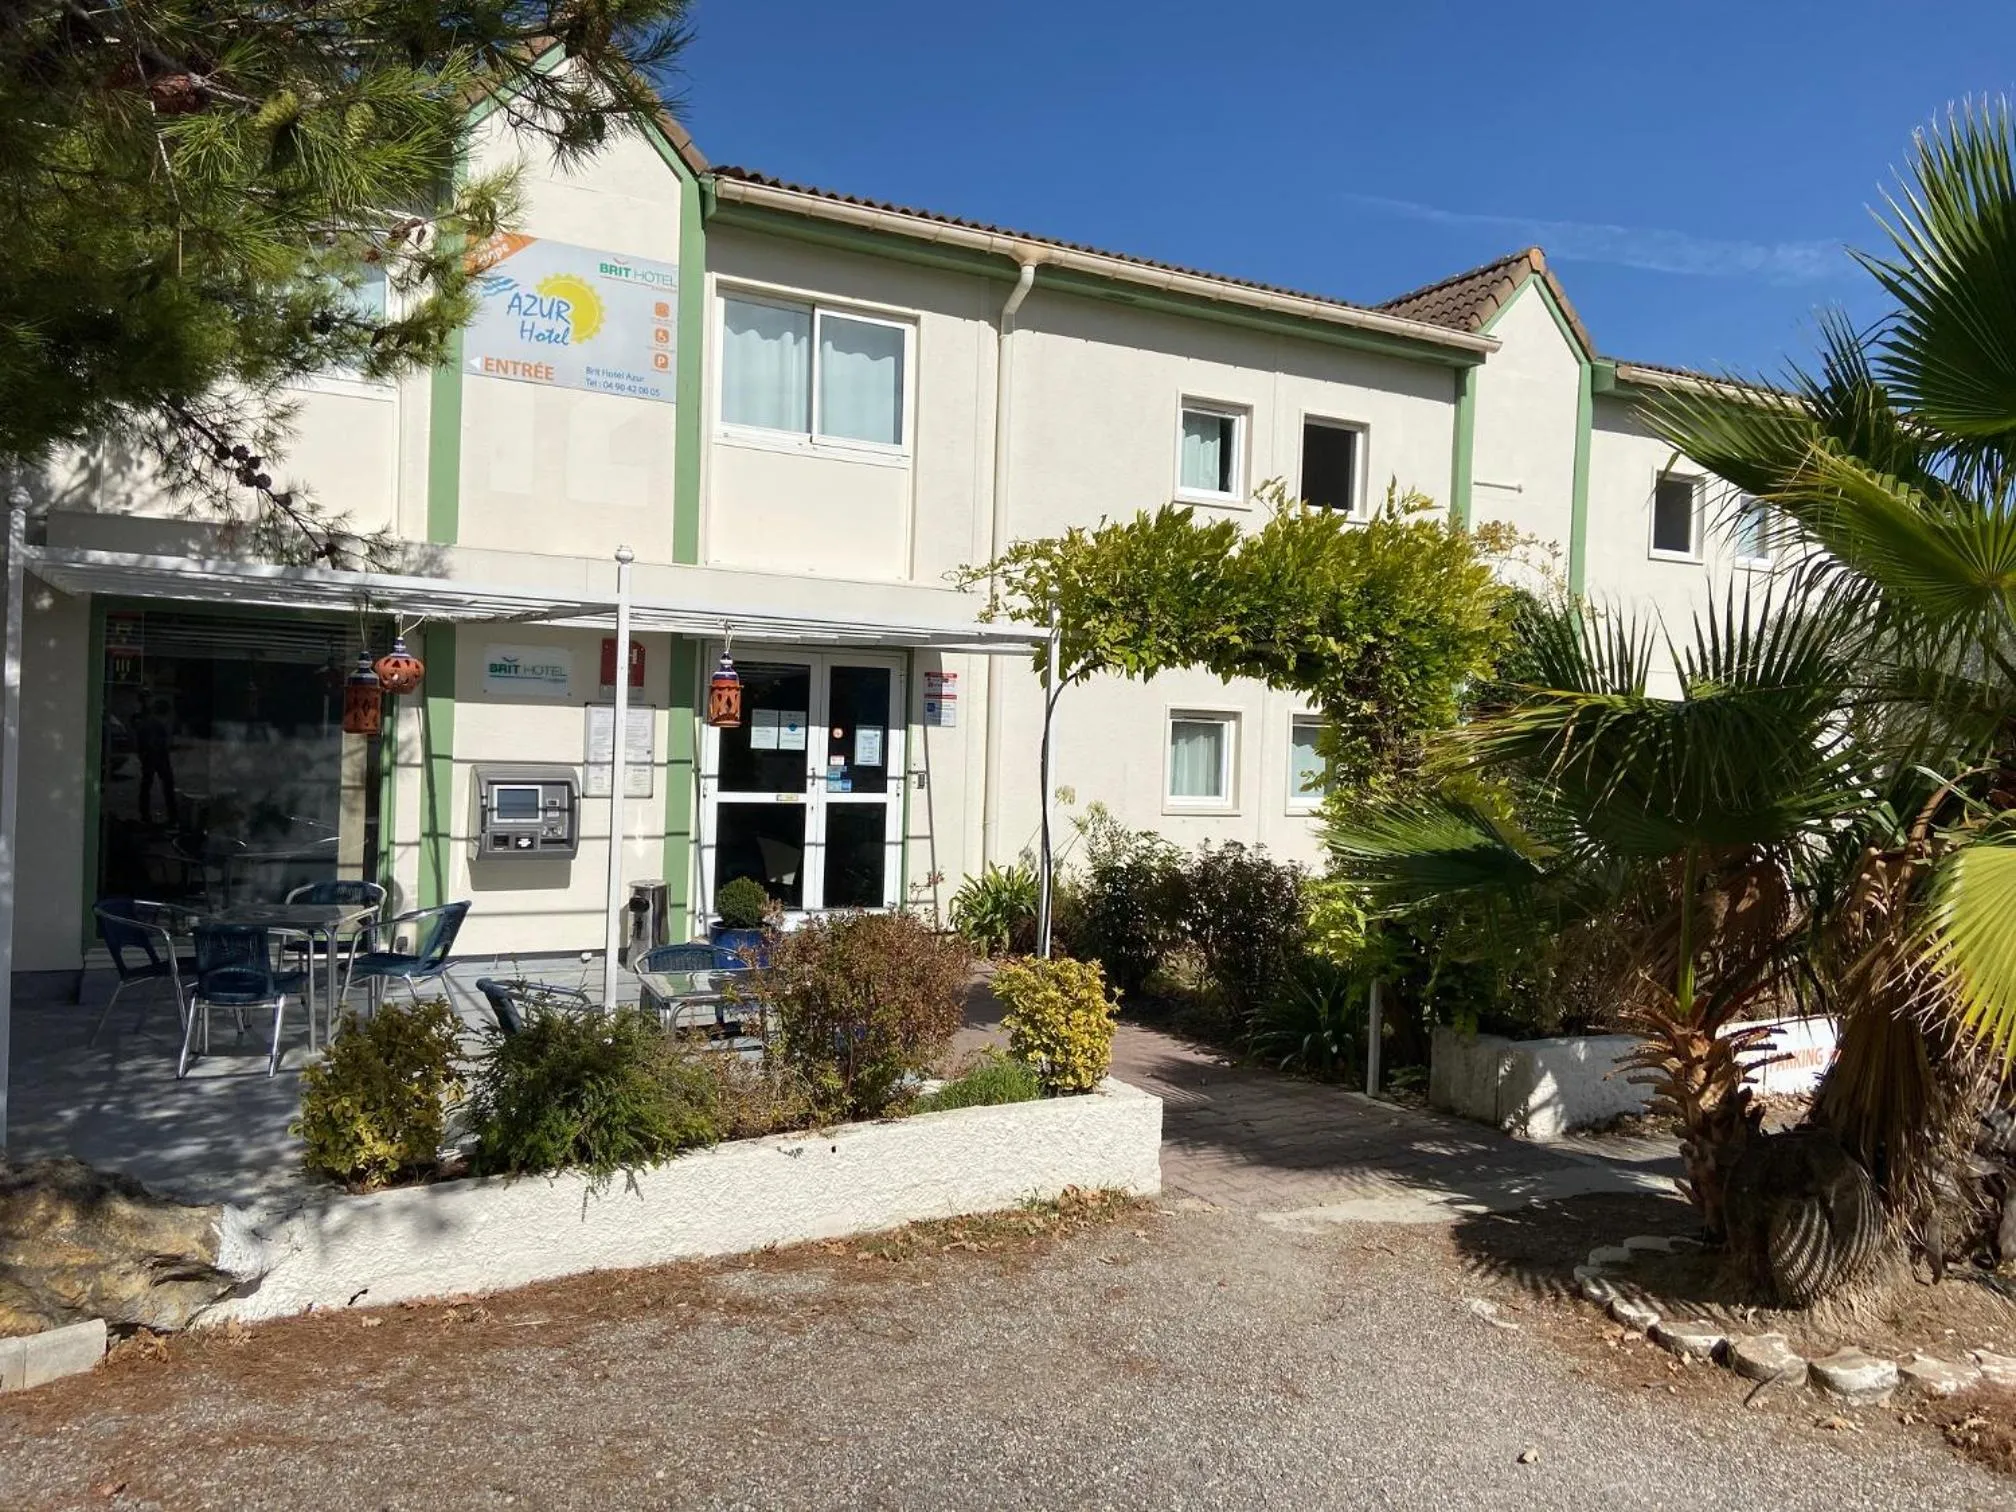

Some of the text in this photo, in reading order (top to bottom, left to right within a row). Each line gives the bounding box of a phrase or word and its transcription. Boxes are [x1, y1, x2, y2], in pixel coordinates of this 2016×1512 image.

[600, 263, 677, 287] BRIT HOTEL
[507, 292, 571, 325] AZUR
[520, 320, 570, 346] Hotel
[484, 356, 555, 380] ENTRÉE
[586, 366, 644, 382] Brit Hotel Azur
[603, 381, 613, 389] 04
[615, 382, 625, 391] 90
[627, 385, 637, 393] 42
[650, 387, 660, 397] 05
[489, 663, 568, 677] BRIT HOTEL
